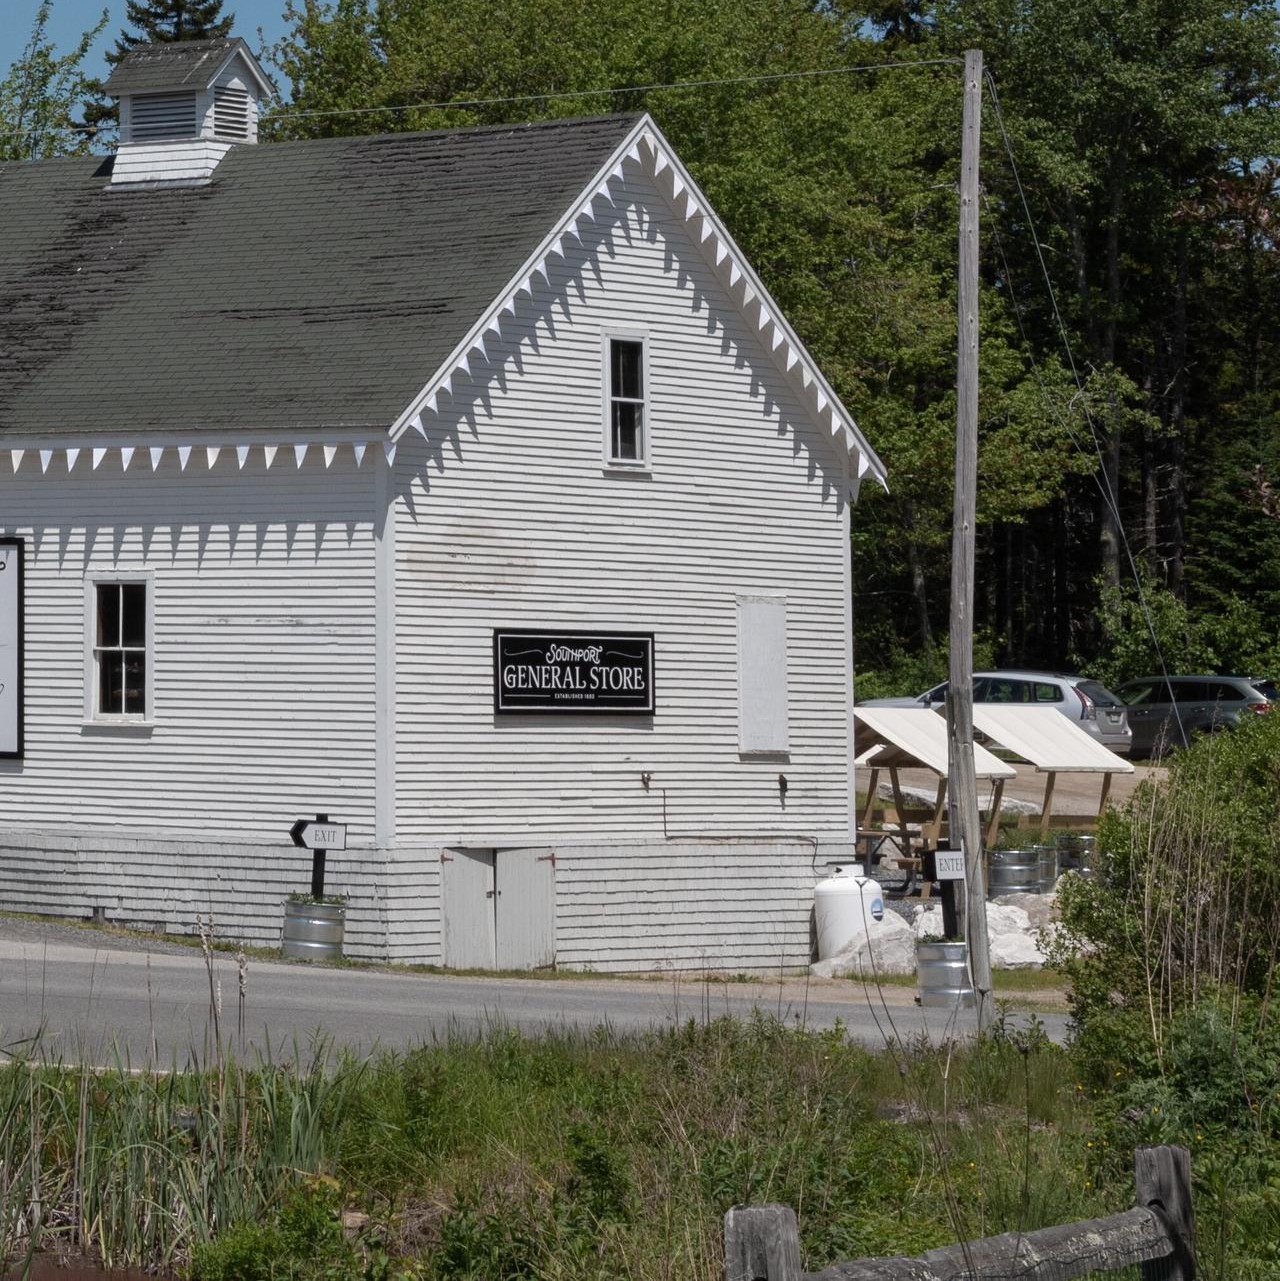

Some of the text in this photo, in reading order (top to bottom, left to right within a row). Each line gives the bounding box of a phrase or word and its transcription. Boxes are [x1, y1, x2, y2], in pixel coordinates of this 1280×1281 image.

[545, 643, 603, 665] SOUTHPORT
[503, 664, 645, 691] GENERAL STORE
[554, 692, 584, 700] ESTABLISHED
[315, 830, 336, 842] EXIT
